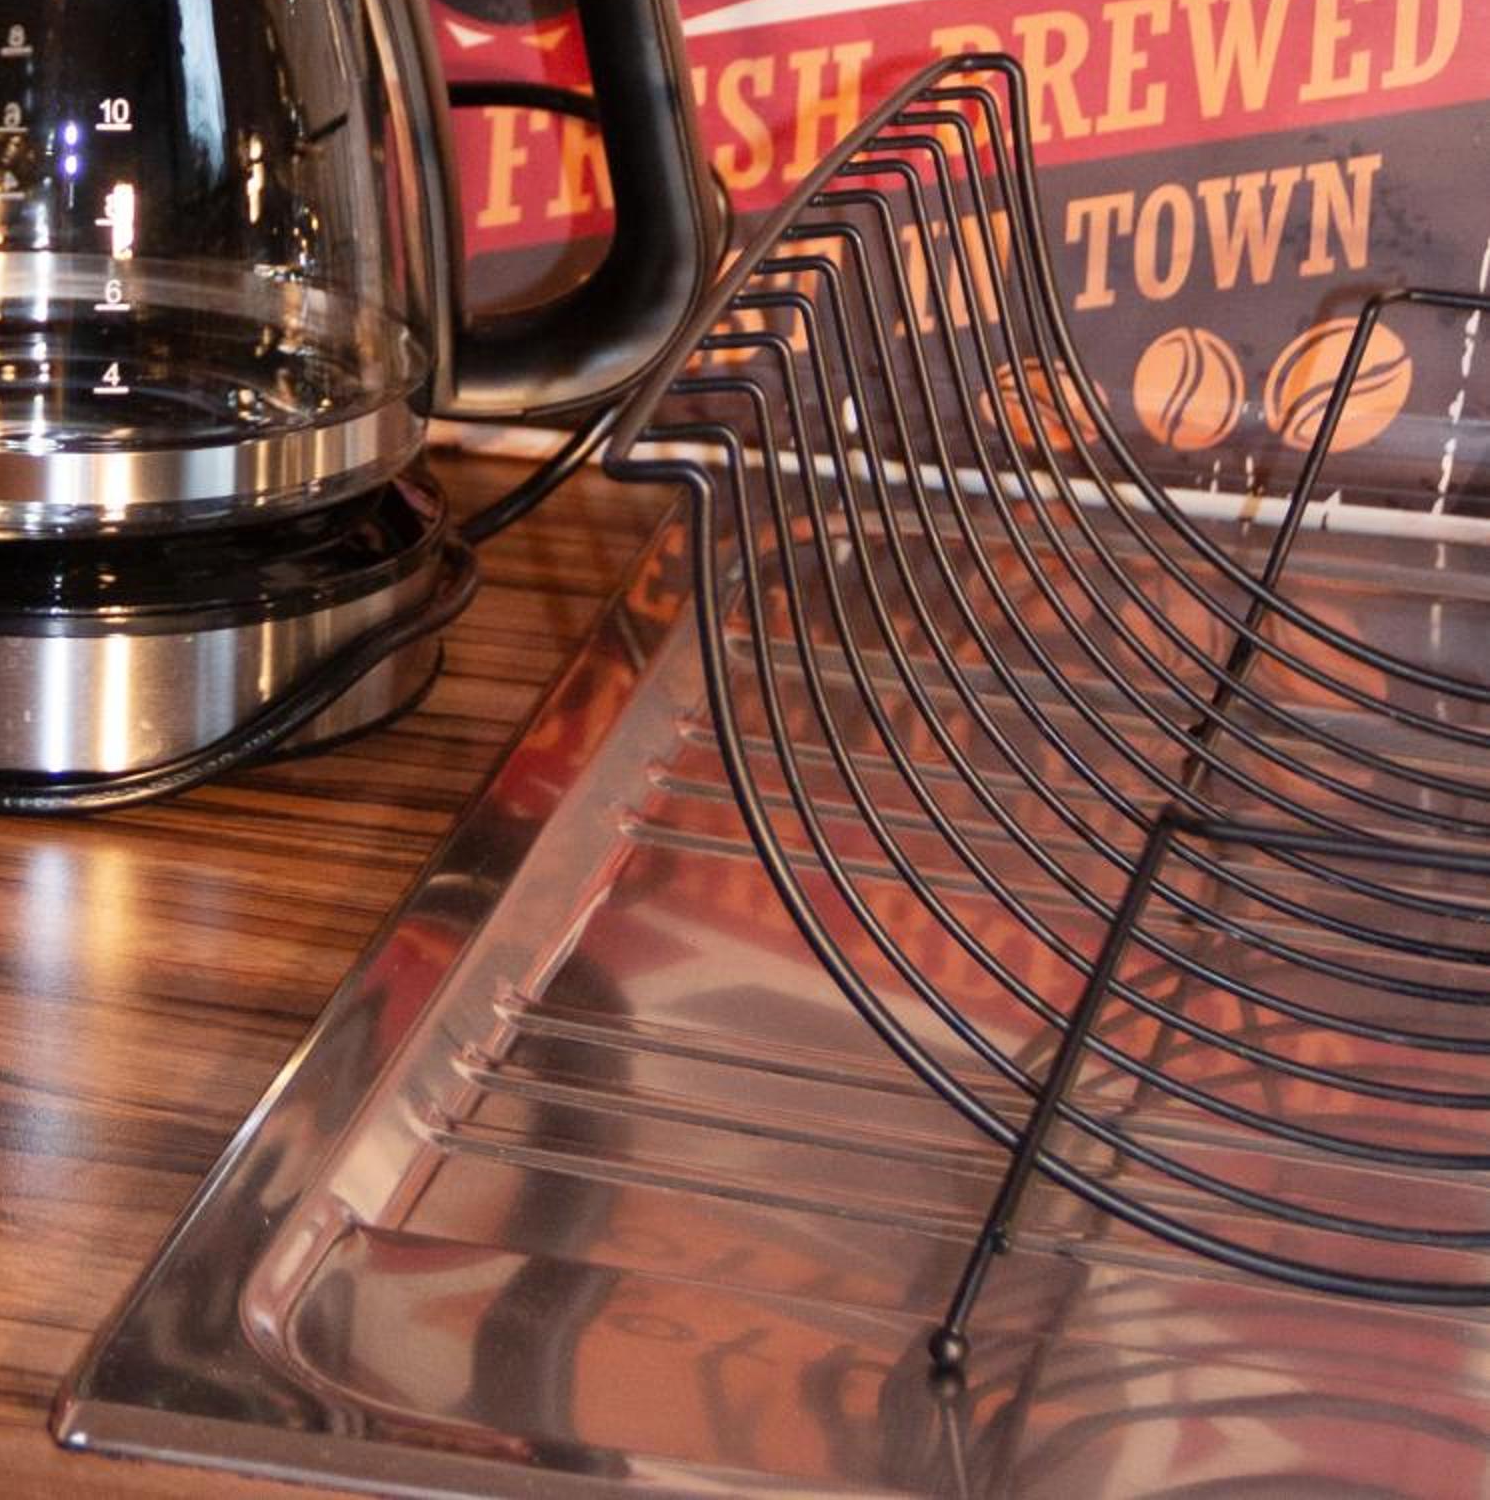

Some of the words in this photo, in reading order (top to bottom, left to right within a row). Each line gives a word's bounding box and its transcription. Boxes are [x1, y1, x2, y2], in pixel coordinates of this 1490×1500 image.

[99, 98, 130, 124] 10
[1065, 154, 1381, 312] TOWN
[105, 280, 122, 304] 6
[102, 362, 121, 387] 4
